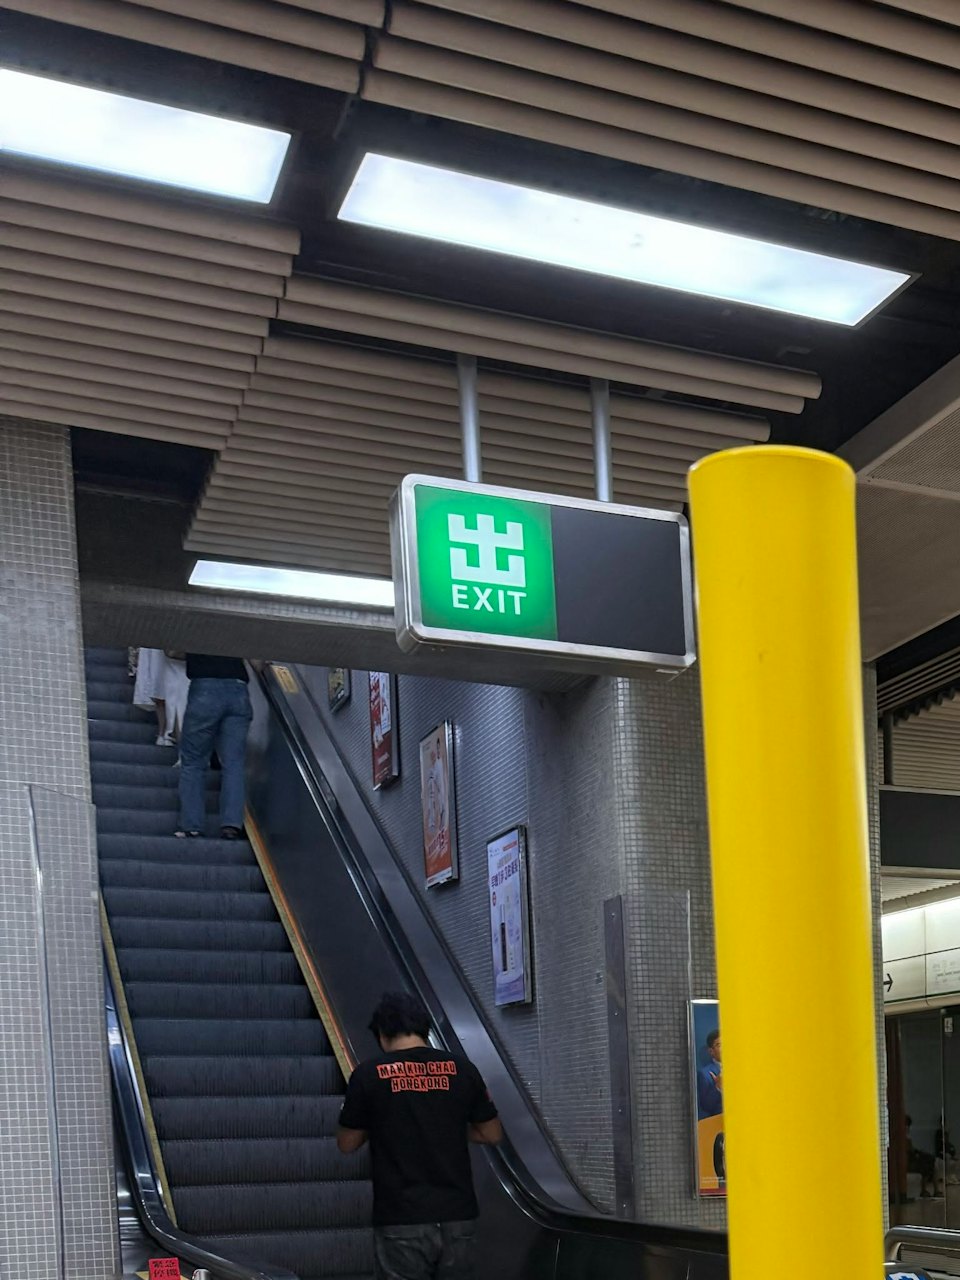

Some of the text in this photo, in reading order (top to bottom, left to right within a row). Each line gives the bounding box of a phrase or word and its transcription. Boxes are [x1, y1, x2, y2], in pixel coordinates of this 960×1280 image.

[451, 583, 527, 615] EXIT
[406, 1062, 425, 1075] KIN
[428, 1061, 456, 1074] CHAU
[392, 1076, 449, 1091] HONGKONG
